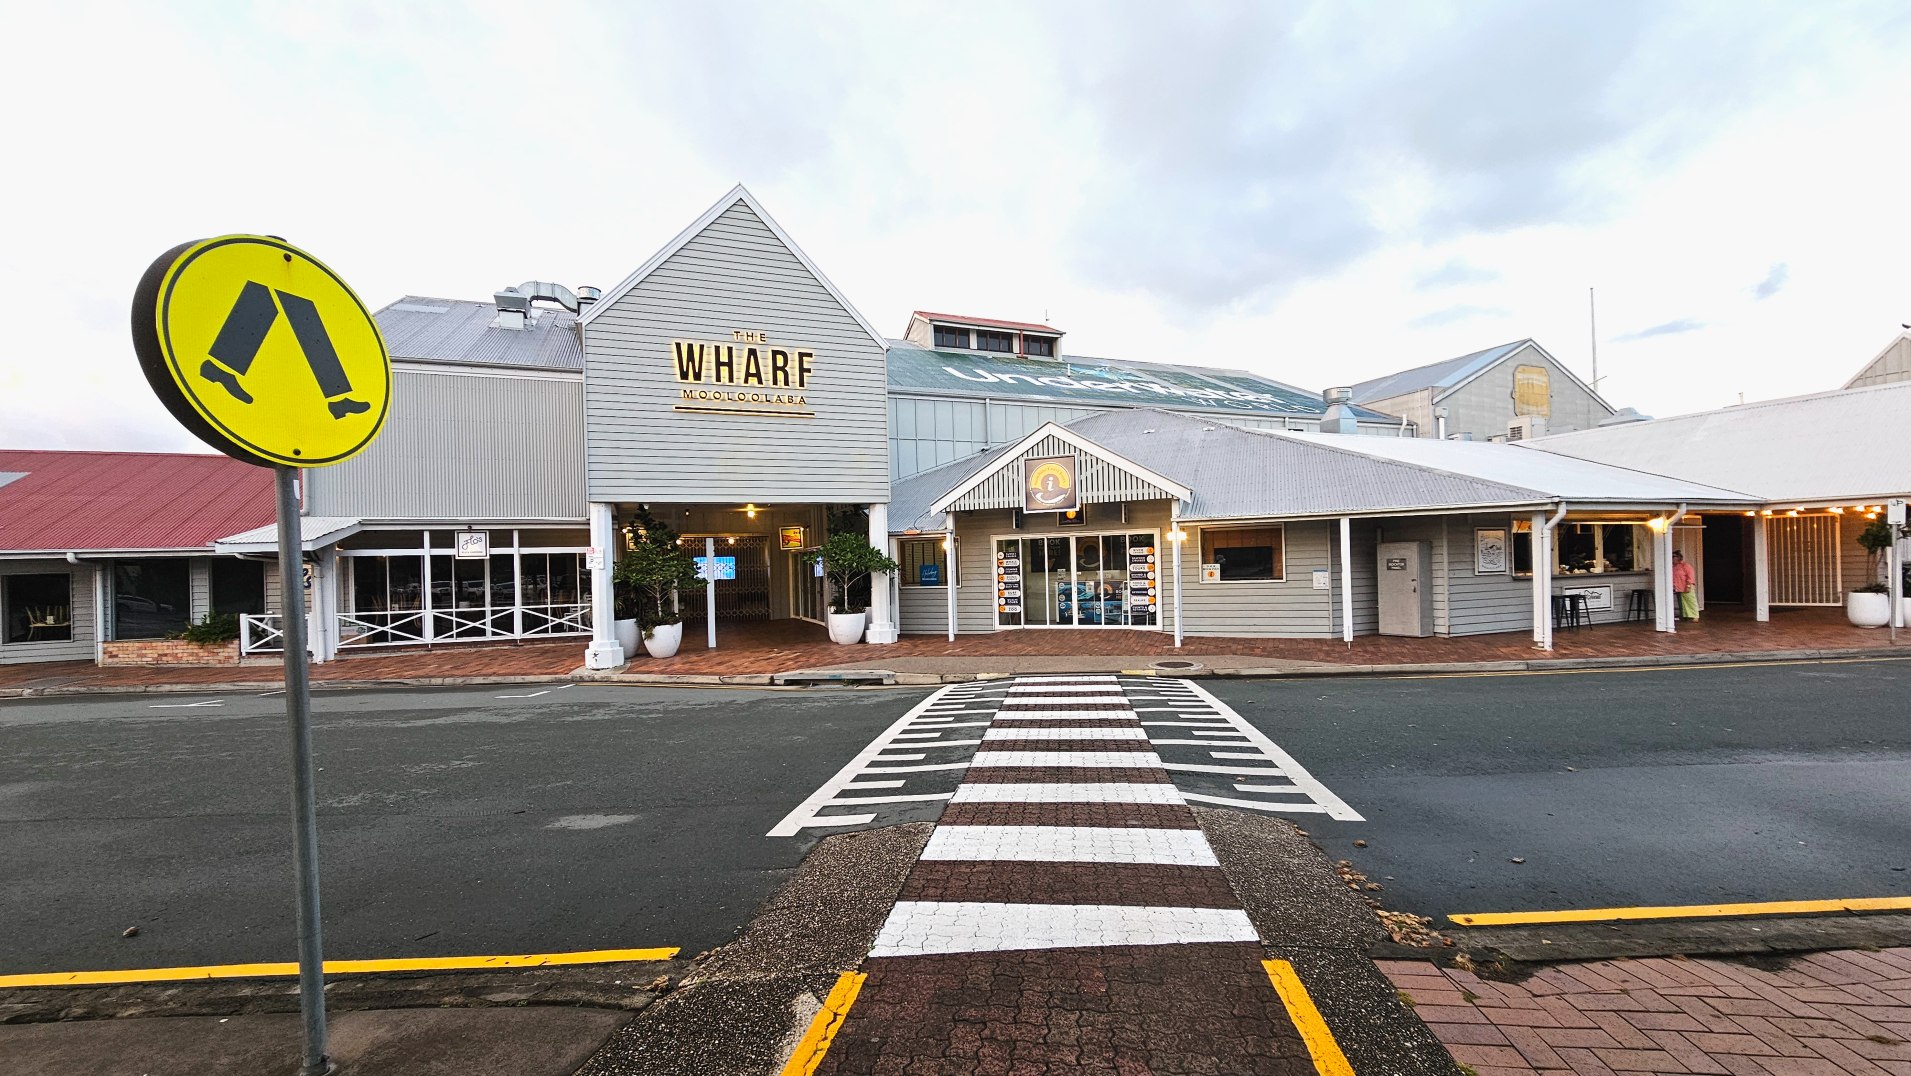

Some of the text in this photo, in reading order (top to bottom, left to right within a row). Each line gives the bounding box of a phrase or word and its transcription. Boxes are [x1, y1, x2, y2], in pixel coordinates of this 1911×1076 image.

[733, 330, 767, 342] THE
[674, 341, 814, 388] WHARF
[682, 389, 807, 404] MOOLOOLABA
[1038, 538, 1061, 546] BOK
